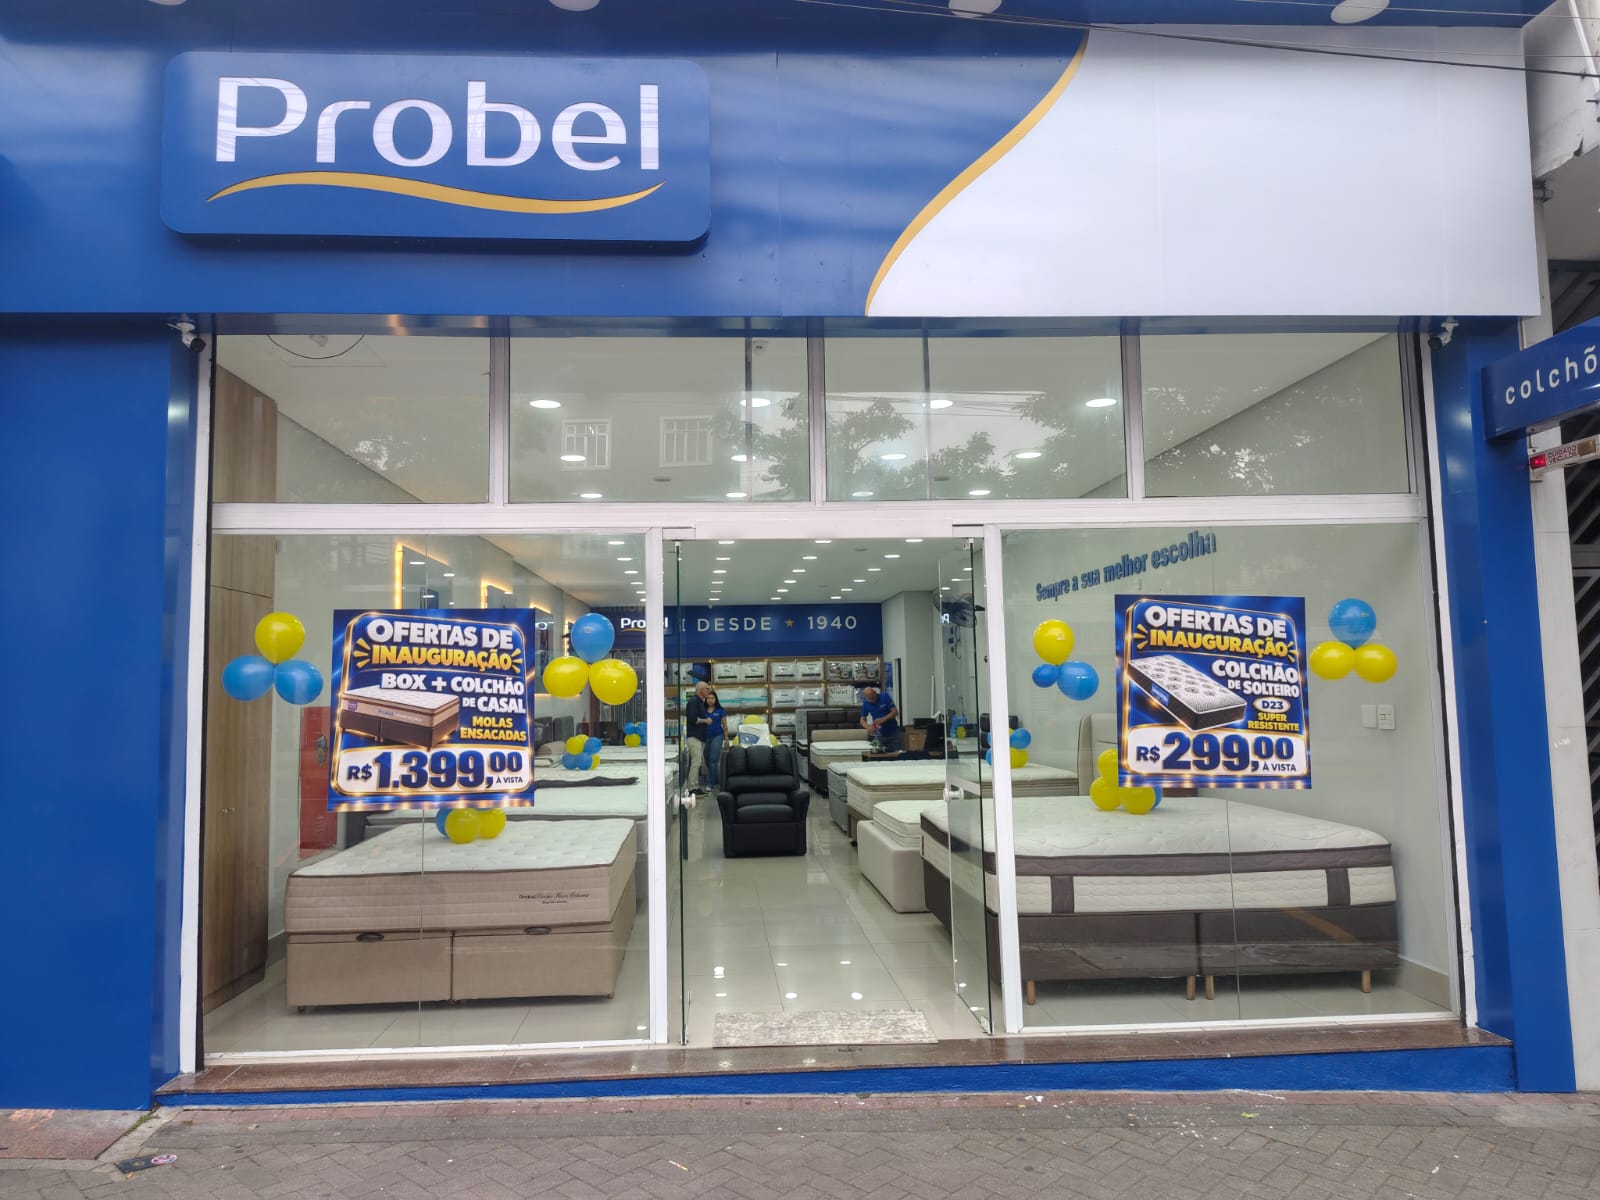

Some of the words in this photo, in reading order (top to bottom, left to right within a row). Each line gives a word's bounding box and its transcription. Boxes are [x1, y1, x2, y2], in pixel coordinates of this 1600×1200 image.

[216, 76, 659, 171] Probel
[1036, 579, 1070, 602] Sempre
[1072, 576, 1079, 591] a
[1081, 569, 1100, 589] sua
[1103, 553, 1148, 583] melhor
[620, 617, 668, 629] Prol
[697, 617, 772, 631] DESDE
[807, 615, 857, 630] 1940
[1145, 606, 1253, 635] OFERTAS
[1257, 618, 1287, 638] DE
[367, 619, 478, 647] OFERTAS
[482, 628, 513, 649] DE
[1150, 630, 1288, 659] INAUGURAÇÃO
[372, 645, 512, 671] INAUGURAÇÃO
[1212, 660, 1298, 682] COLCHÃO
[382, 673, 426, 690] BOX
[451, 675, 524, 695] COLCHÃO
[1228, 679, 1240, 690] DE
[1243, 681, 1299, 697] SOLTEIRO
[463, 698, 475, 708] DE
[477, 696, 526, 713] CASAL
[1262, 700, 1284, 710] D23
[472, 716, 513, 728] MOLAS
[1248, 721, 1299, 731] RESISTENTE
[1258, 713, 1287, 722] SUPER
[460, 729, 526, 741] ENSACADAS
[1136, 746, 1160, 763] R$
[347, 764, 372, 781] R$
[1270, 763, 1297, 771] VISTA
